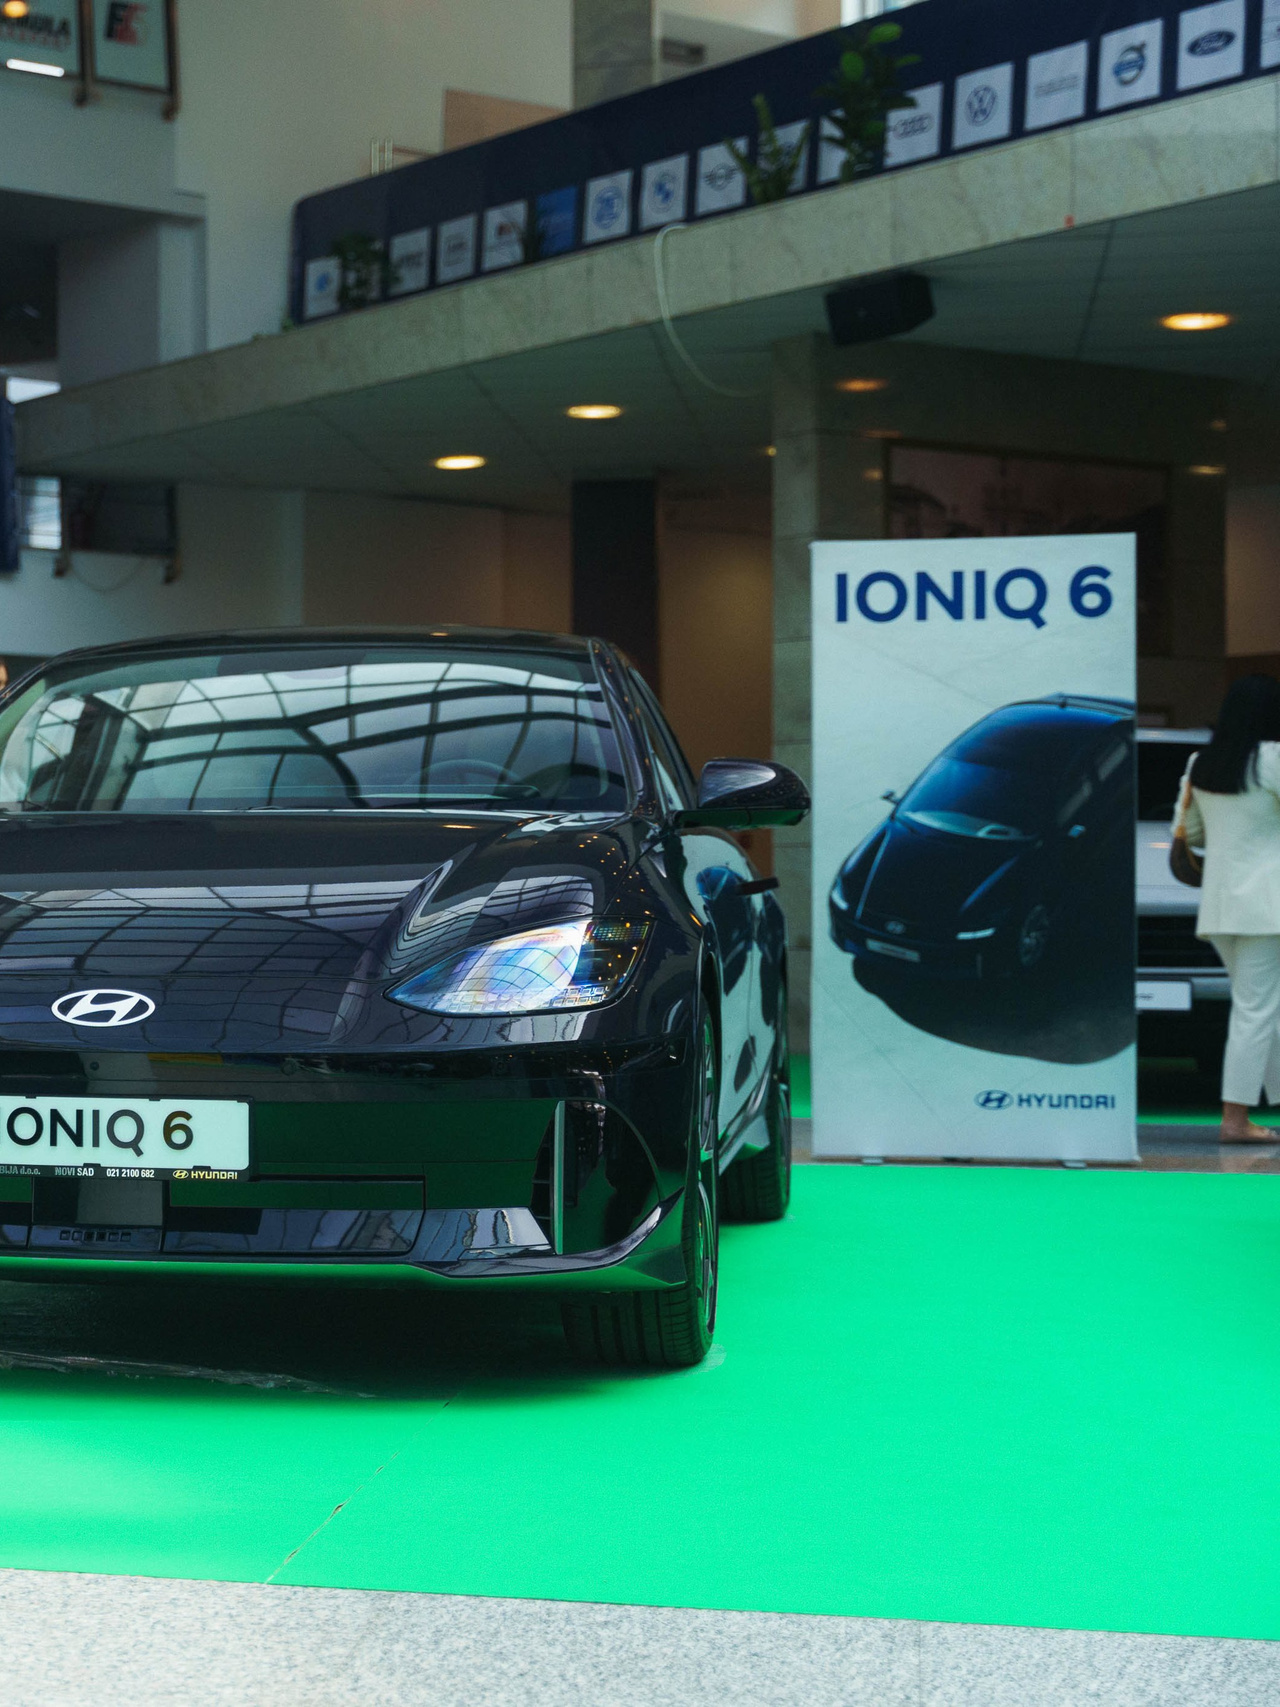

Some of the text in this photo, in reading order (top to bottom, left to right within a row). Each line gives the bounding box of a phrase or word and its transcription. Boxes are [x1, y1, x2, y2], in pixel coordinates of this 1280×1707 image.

[835, 565, 1113, 630] IONIQ 6
[1017, 1092, 1116, 1109] HYUNDAI
[162, 1110, 194, 1151] 6
[19, 1165, 41, 1175] d.o.o.
[55, 1166, 76, 1176] NOVI
[76, 1167, 95, 1177] SAD
[106, 1168, 120, 1178] 021
[121, 1168, 140, 1178] 2100
[140, 1169, 155, 1178] 682
[190, 1170, 238, 1180] HYUNDAI
